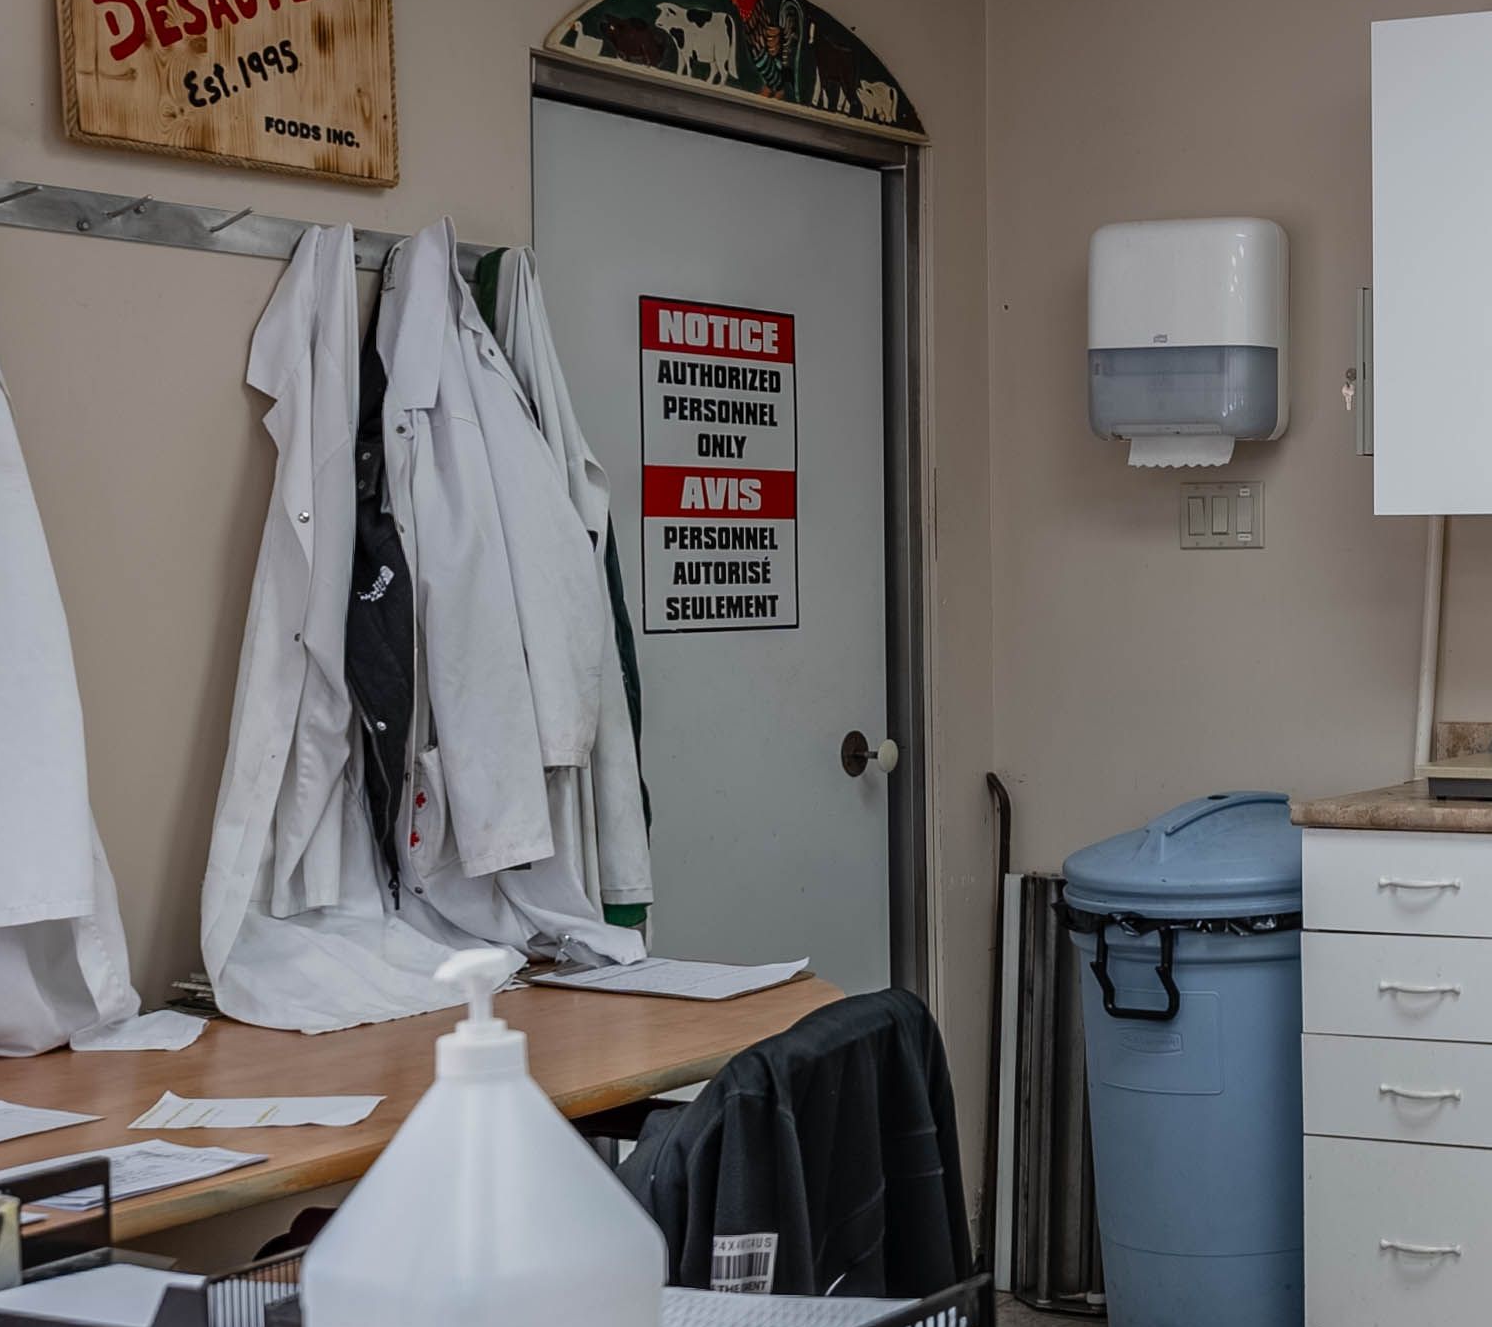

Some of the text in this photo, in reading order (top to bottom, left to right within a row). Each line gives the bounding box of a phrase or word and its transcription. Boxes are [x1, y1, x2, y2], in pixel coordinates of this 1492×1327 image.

[264, 116, 361, 149] FOODS INC.
[658, 308, 780, 356] NOTICE
[657, 358, 782, 394] AUTHORIZED
[662, 394, 779, 428] PERSONNEL
[696, 432, 748, 460] ONLY
[680, 476, 763, 512] AVIS
[663, 525, 779, 551] PERSONNEL
[672, 554, 772, 586] AUTORISÉ
[665, 593, 780, 622] SEULEMENT
